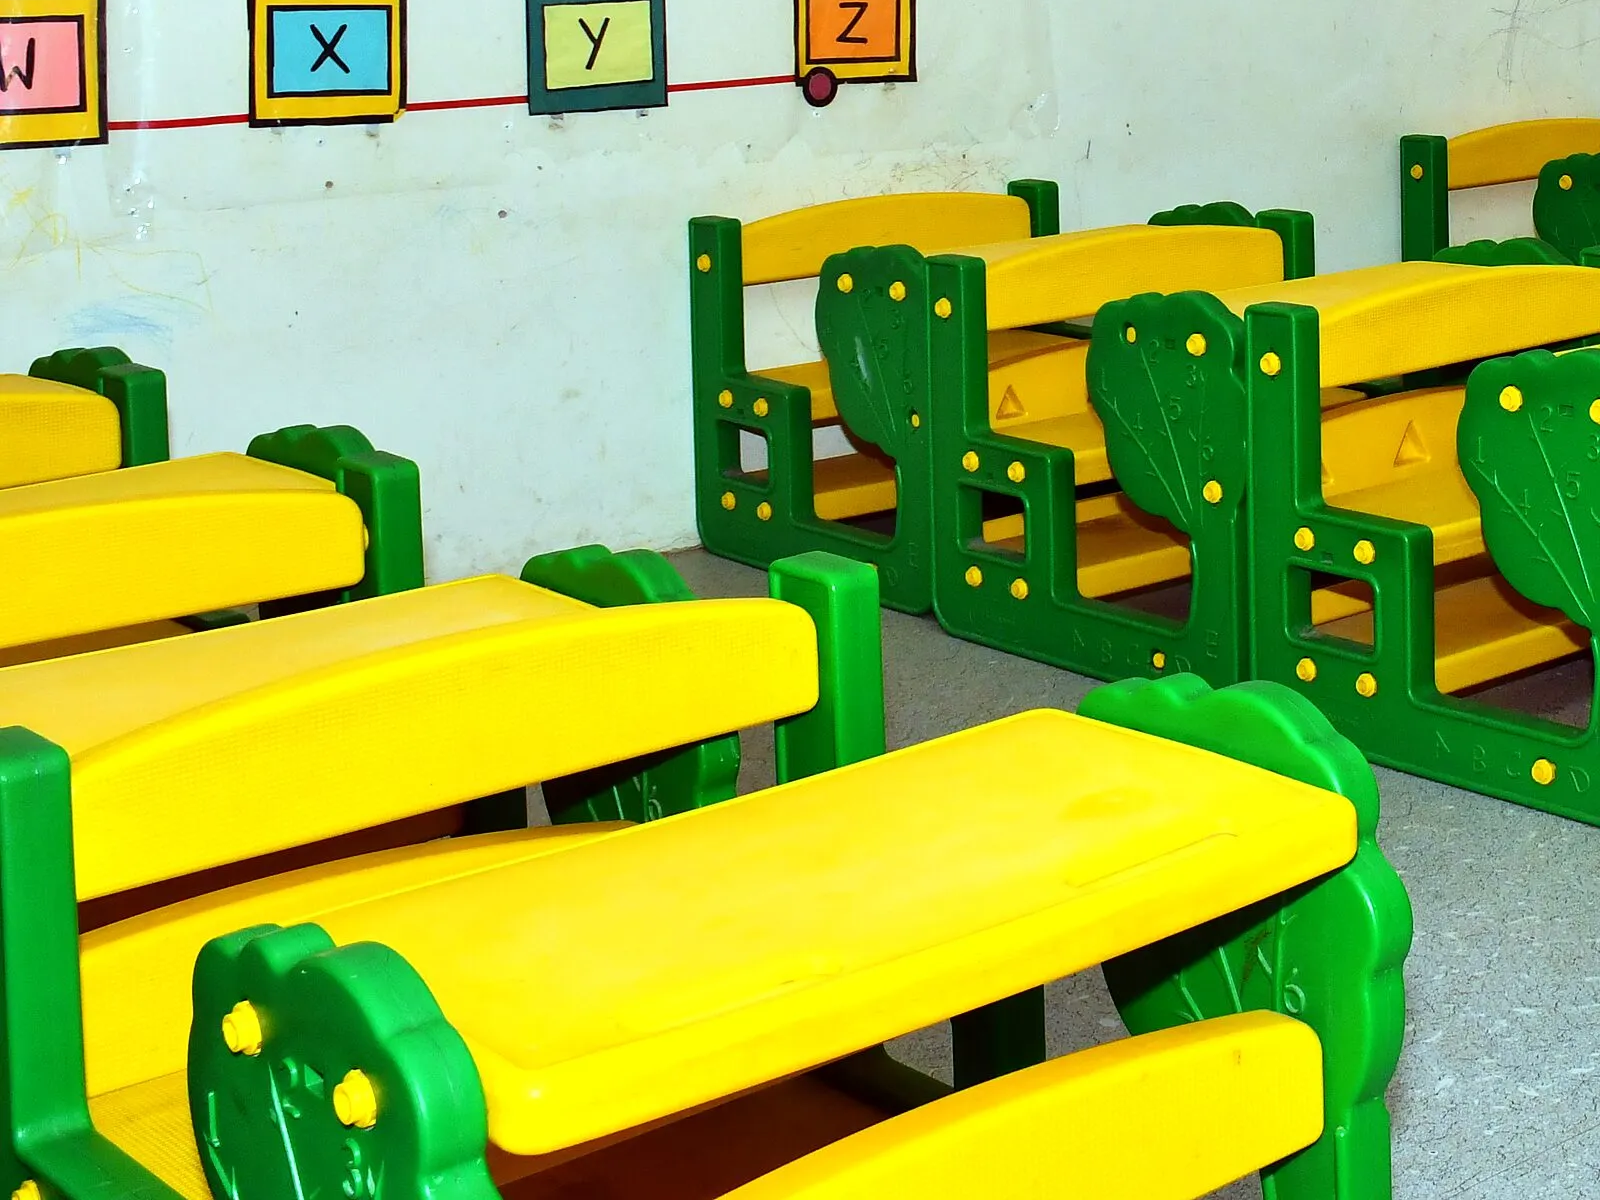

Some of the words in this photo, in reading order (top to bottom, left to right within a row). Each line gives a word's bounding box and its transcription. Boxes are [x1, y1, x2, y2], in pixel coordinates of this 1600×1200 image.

[0, 37, 35, 92] W
[310, 24, 350, 73] X
[578, 18, 610, 70] Y
[835, 2, 868, 44] Z
[1149, 338, 1160, 365] 2
[1186, 364, 1198, 387] 3
[1168, 396, 1182, 420] 5
[1540, 404, 1553, 432] 2
[1477, 435, 1485, 464] 1
[1587, 434, 1600, 460] 3
[1565, 471, 1581, 499] 5
[1519, 488, 1531, 516] 4
[1435, 730, 1451, 758] A
[1471, 744, 1487, 772] B
[1506, 751, 1521, 777] C
[1568, 766, 1591, 793] D
